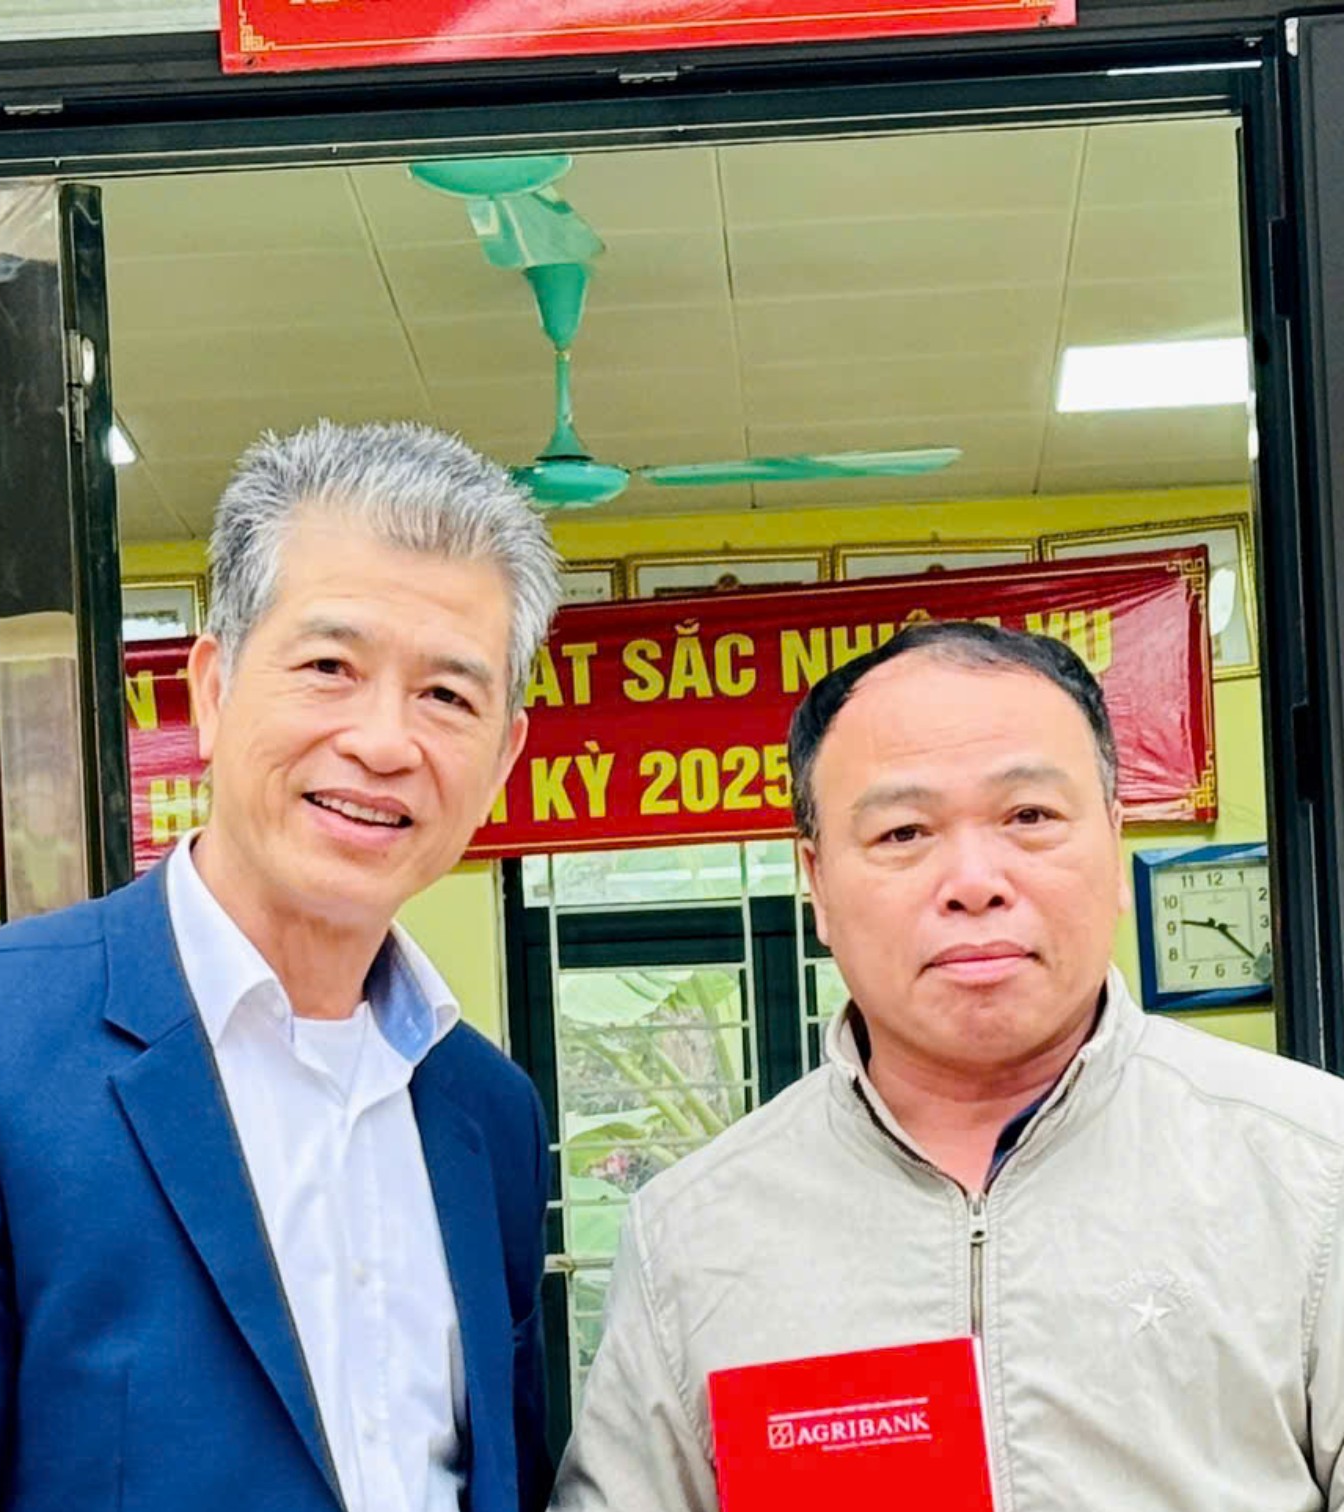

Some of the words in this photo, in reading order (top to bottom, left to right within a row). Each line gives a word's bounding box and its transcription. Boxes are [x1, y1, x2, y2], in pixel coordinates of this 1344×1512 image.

[622, 617, 757, 702] SẮC
[530, 741, 615, 823] KỲ
[1181, 875, 1194, 888] 11
[1206, 872, 1223, 886] 12
[1238, 871, 1244, 884] 1
[1258, 887, 1268, 901] 2
[1163, 895, 1178, 908] 10
[1167, 921, 1177, 935] 9
[1260, 915, 1269, 928] 3
[1168, 947, 1178, 961] 8
[1189, 965, 1199, 979] 7
[1215, 963, 1226, 977] 6
[1241, 961, 1251, 975] 5
[796, 1411, 930, 1445] AGRIBANK
